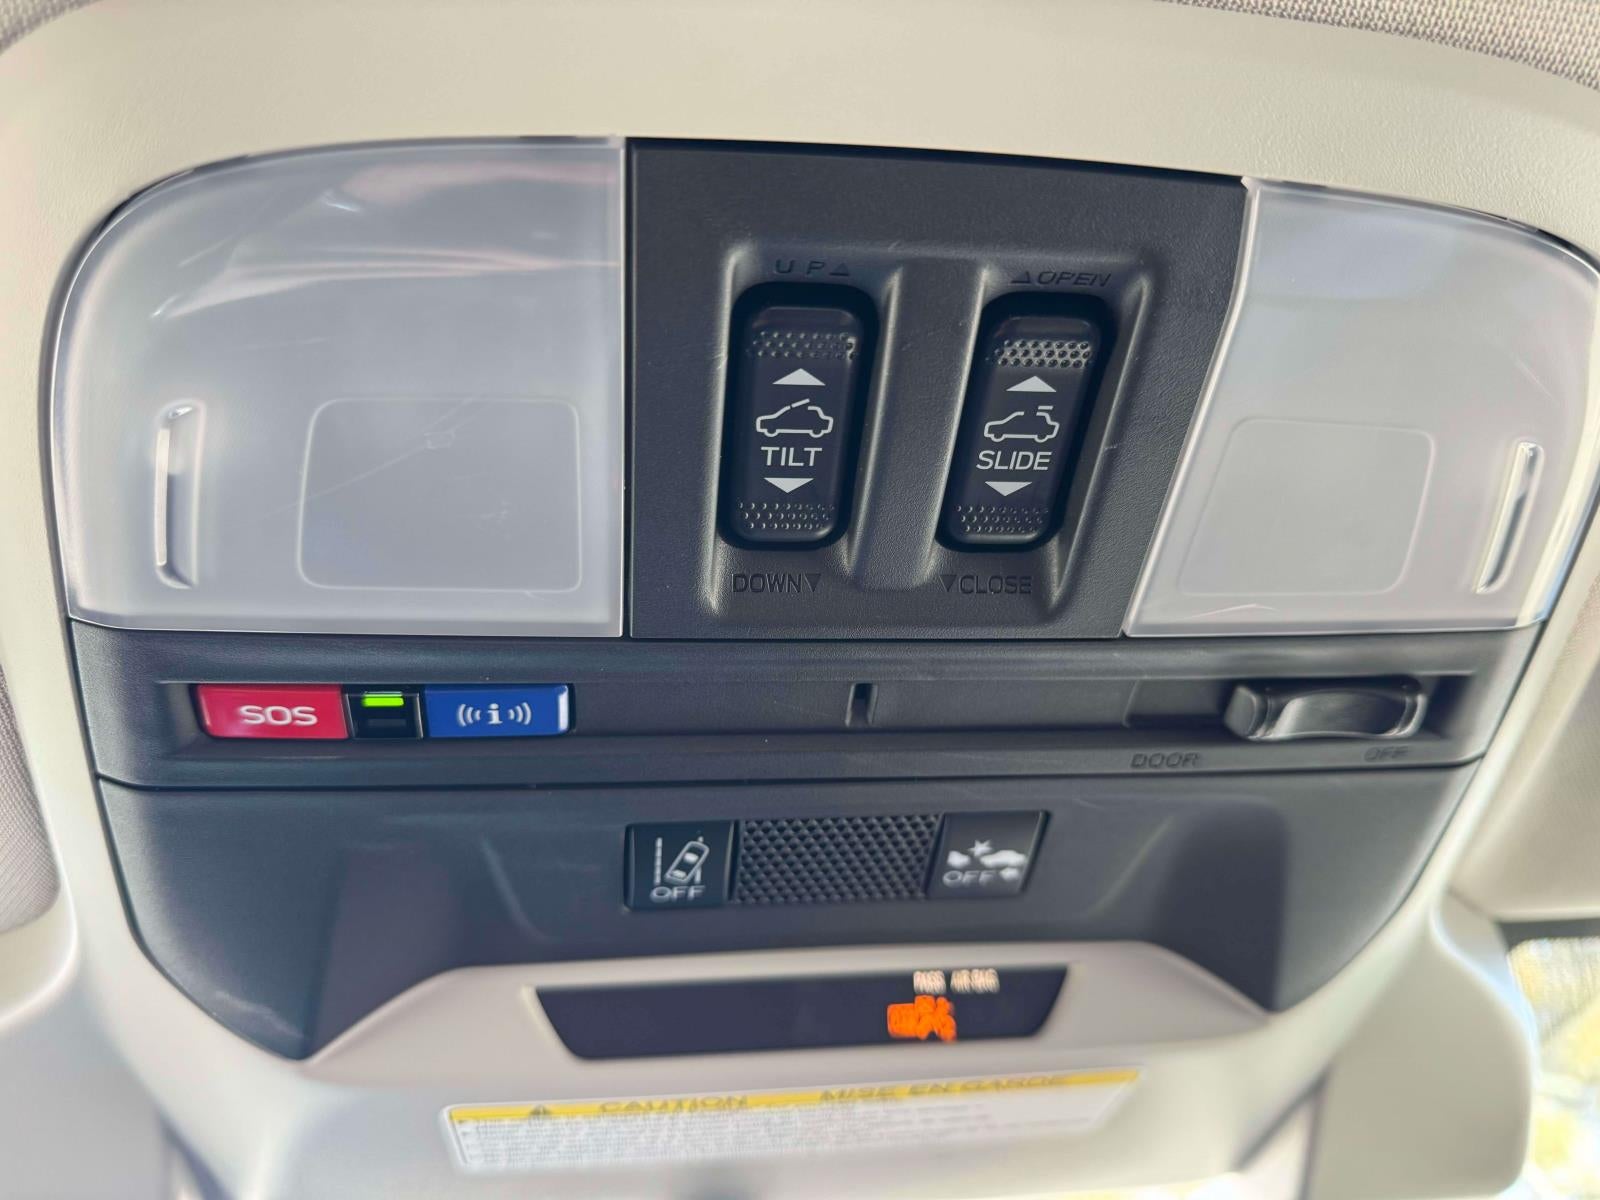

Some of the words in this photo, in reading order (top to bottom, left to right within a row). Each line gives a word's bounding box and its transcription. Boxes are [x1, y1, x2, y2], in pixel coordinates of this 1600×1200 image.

[1037, 270, 1112, 288] OPEN
[760, 446, 823, 467] TILT
[975, 450, 1053, 471] SLIDE
[731, 573, 801, 593] DOWN
[959, 574, 1032, 594] CLOSE
[239, 705, 318, 726] SOS
[1130, 752, 1200, 769] DOOR
[1364, 745, 1408, 763] OFF
[942, 870, 993, 886] OFF
[650, 885, 705, 903] OFF
[819, 1084, 898, 1101] MISE
[600, 1095, 749, 1114] CAUTION
